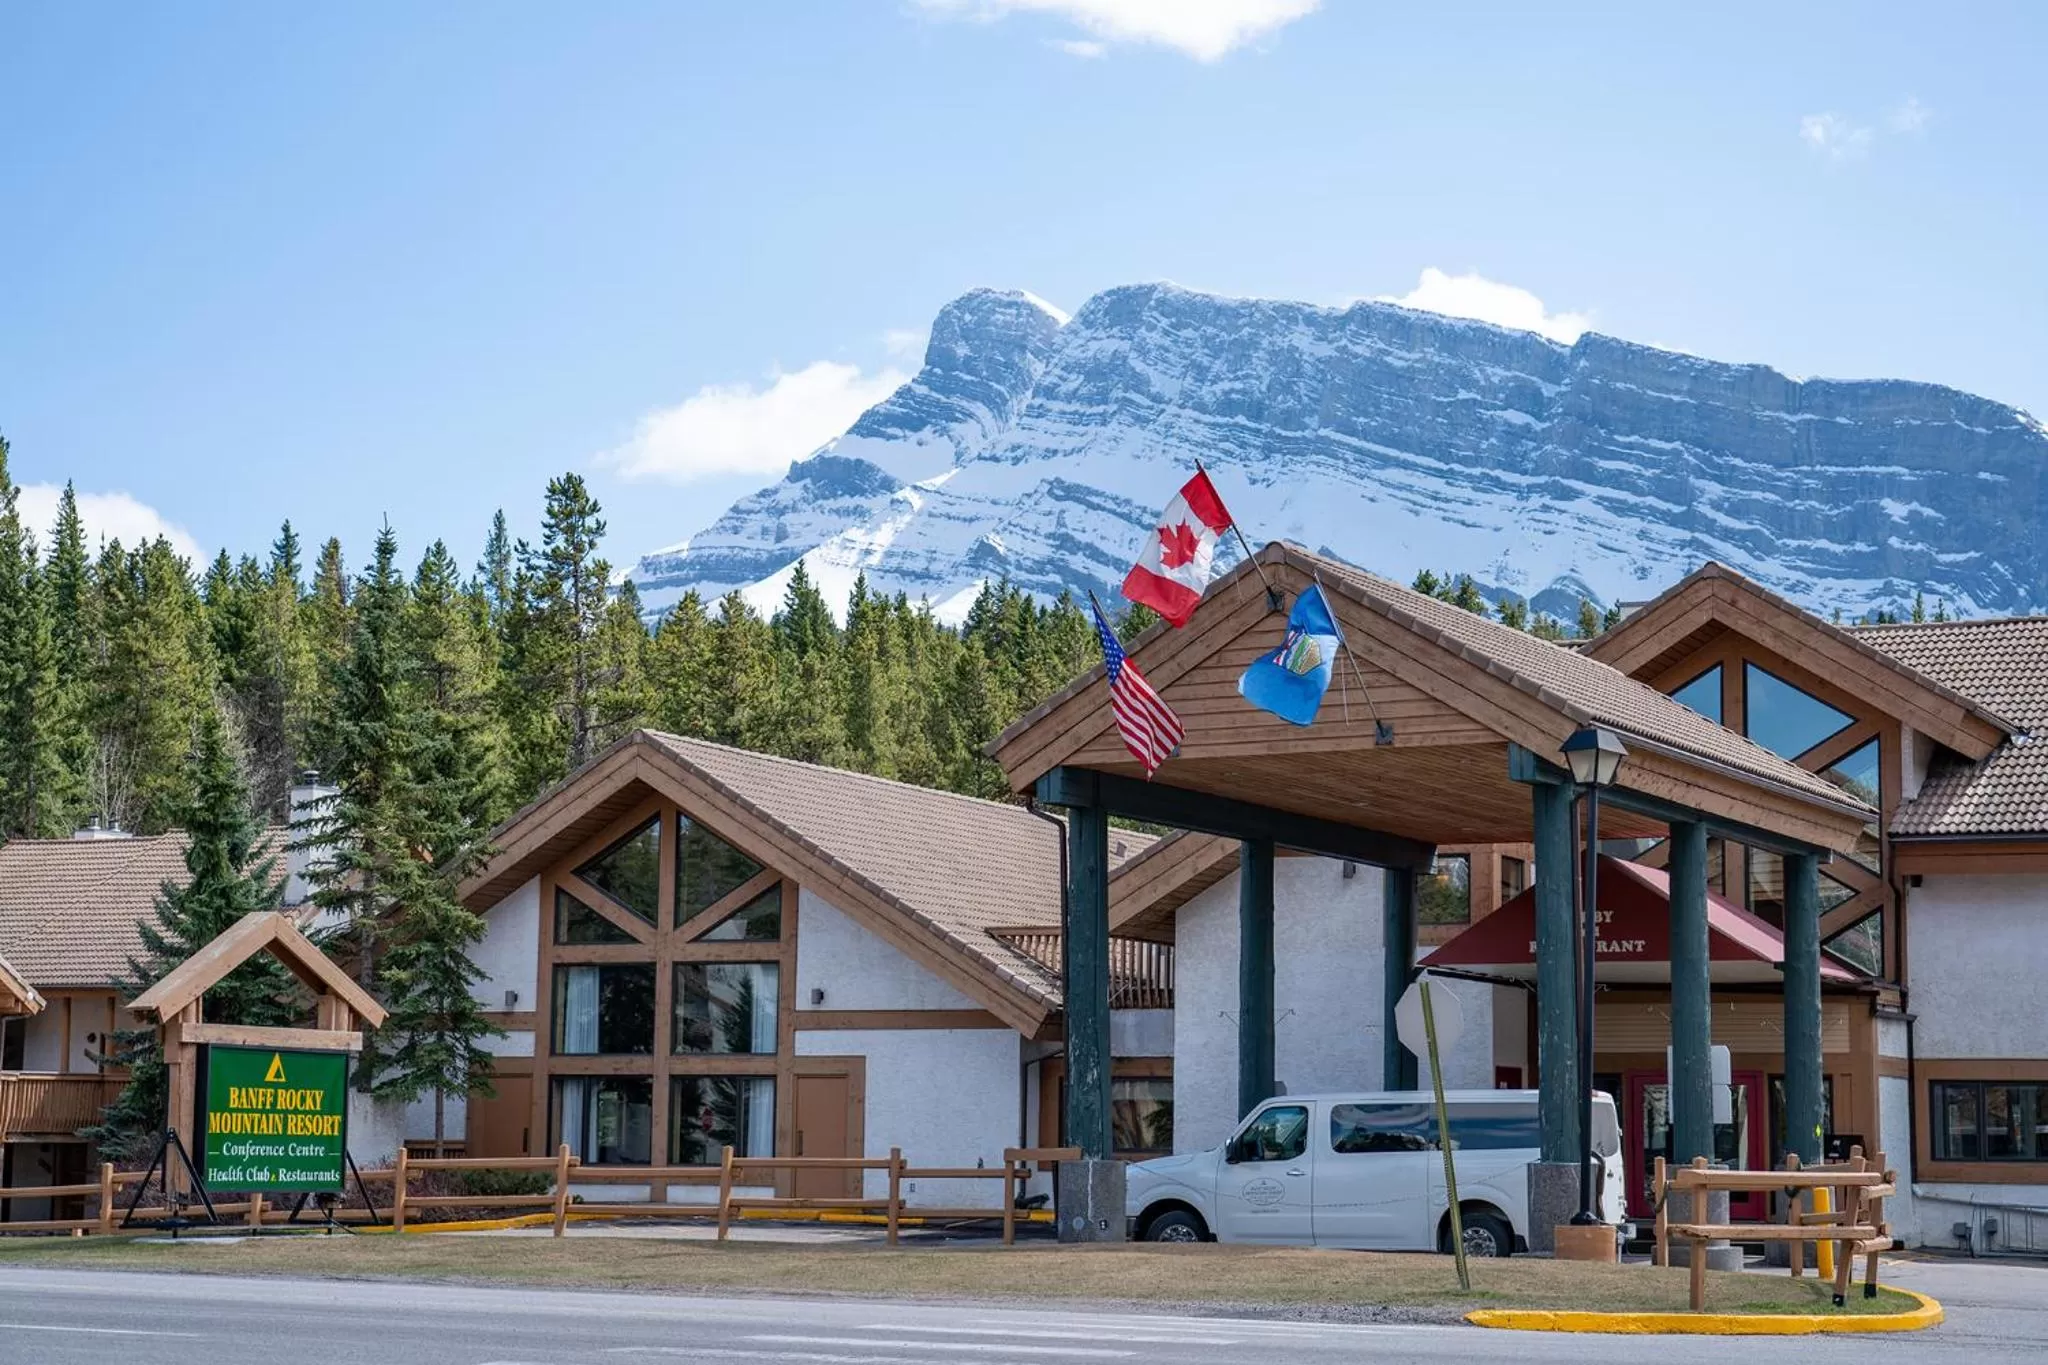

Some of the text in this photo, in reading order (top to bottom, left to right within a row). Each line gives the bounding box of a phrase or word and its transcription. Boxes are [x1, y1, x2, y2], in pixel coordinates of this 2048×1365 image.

[229, 1087, 324, 1111] BANFF ROCKY
[208, 1112, 342, 1136] MOUNTAIN RESORT
[223, 1140, 325, 1162] Conference Centre
[208, 1166, 340, 1182] Health Club Restaurants
